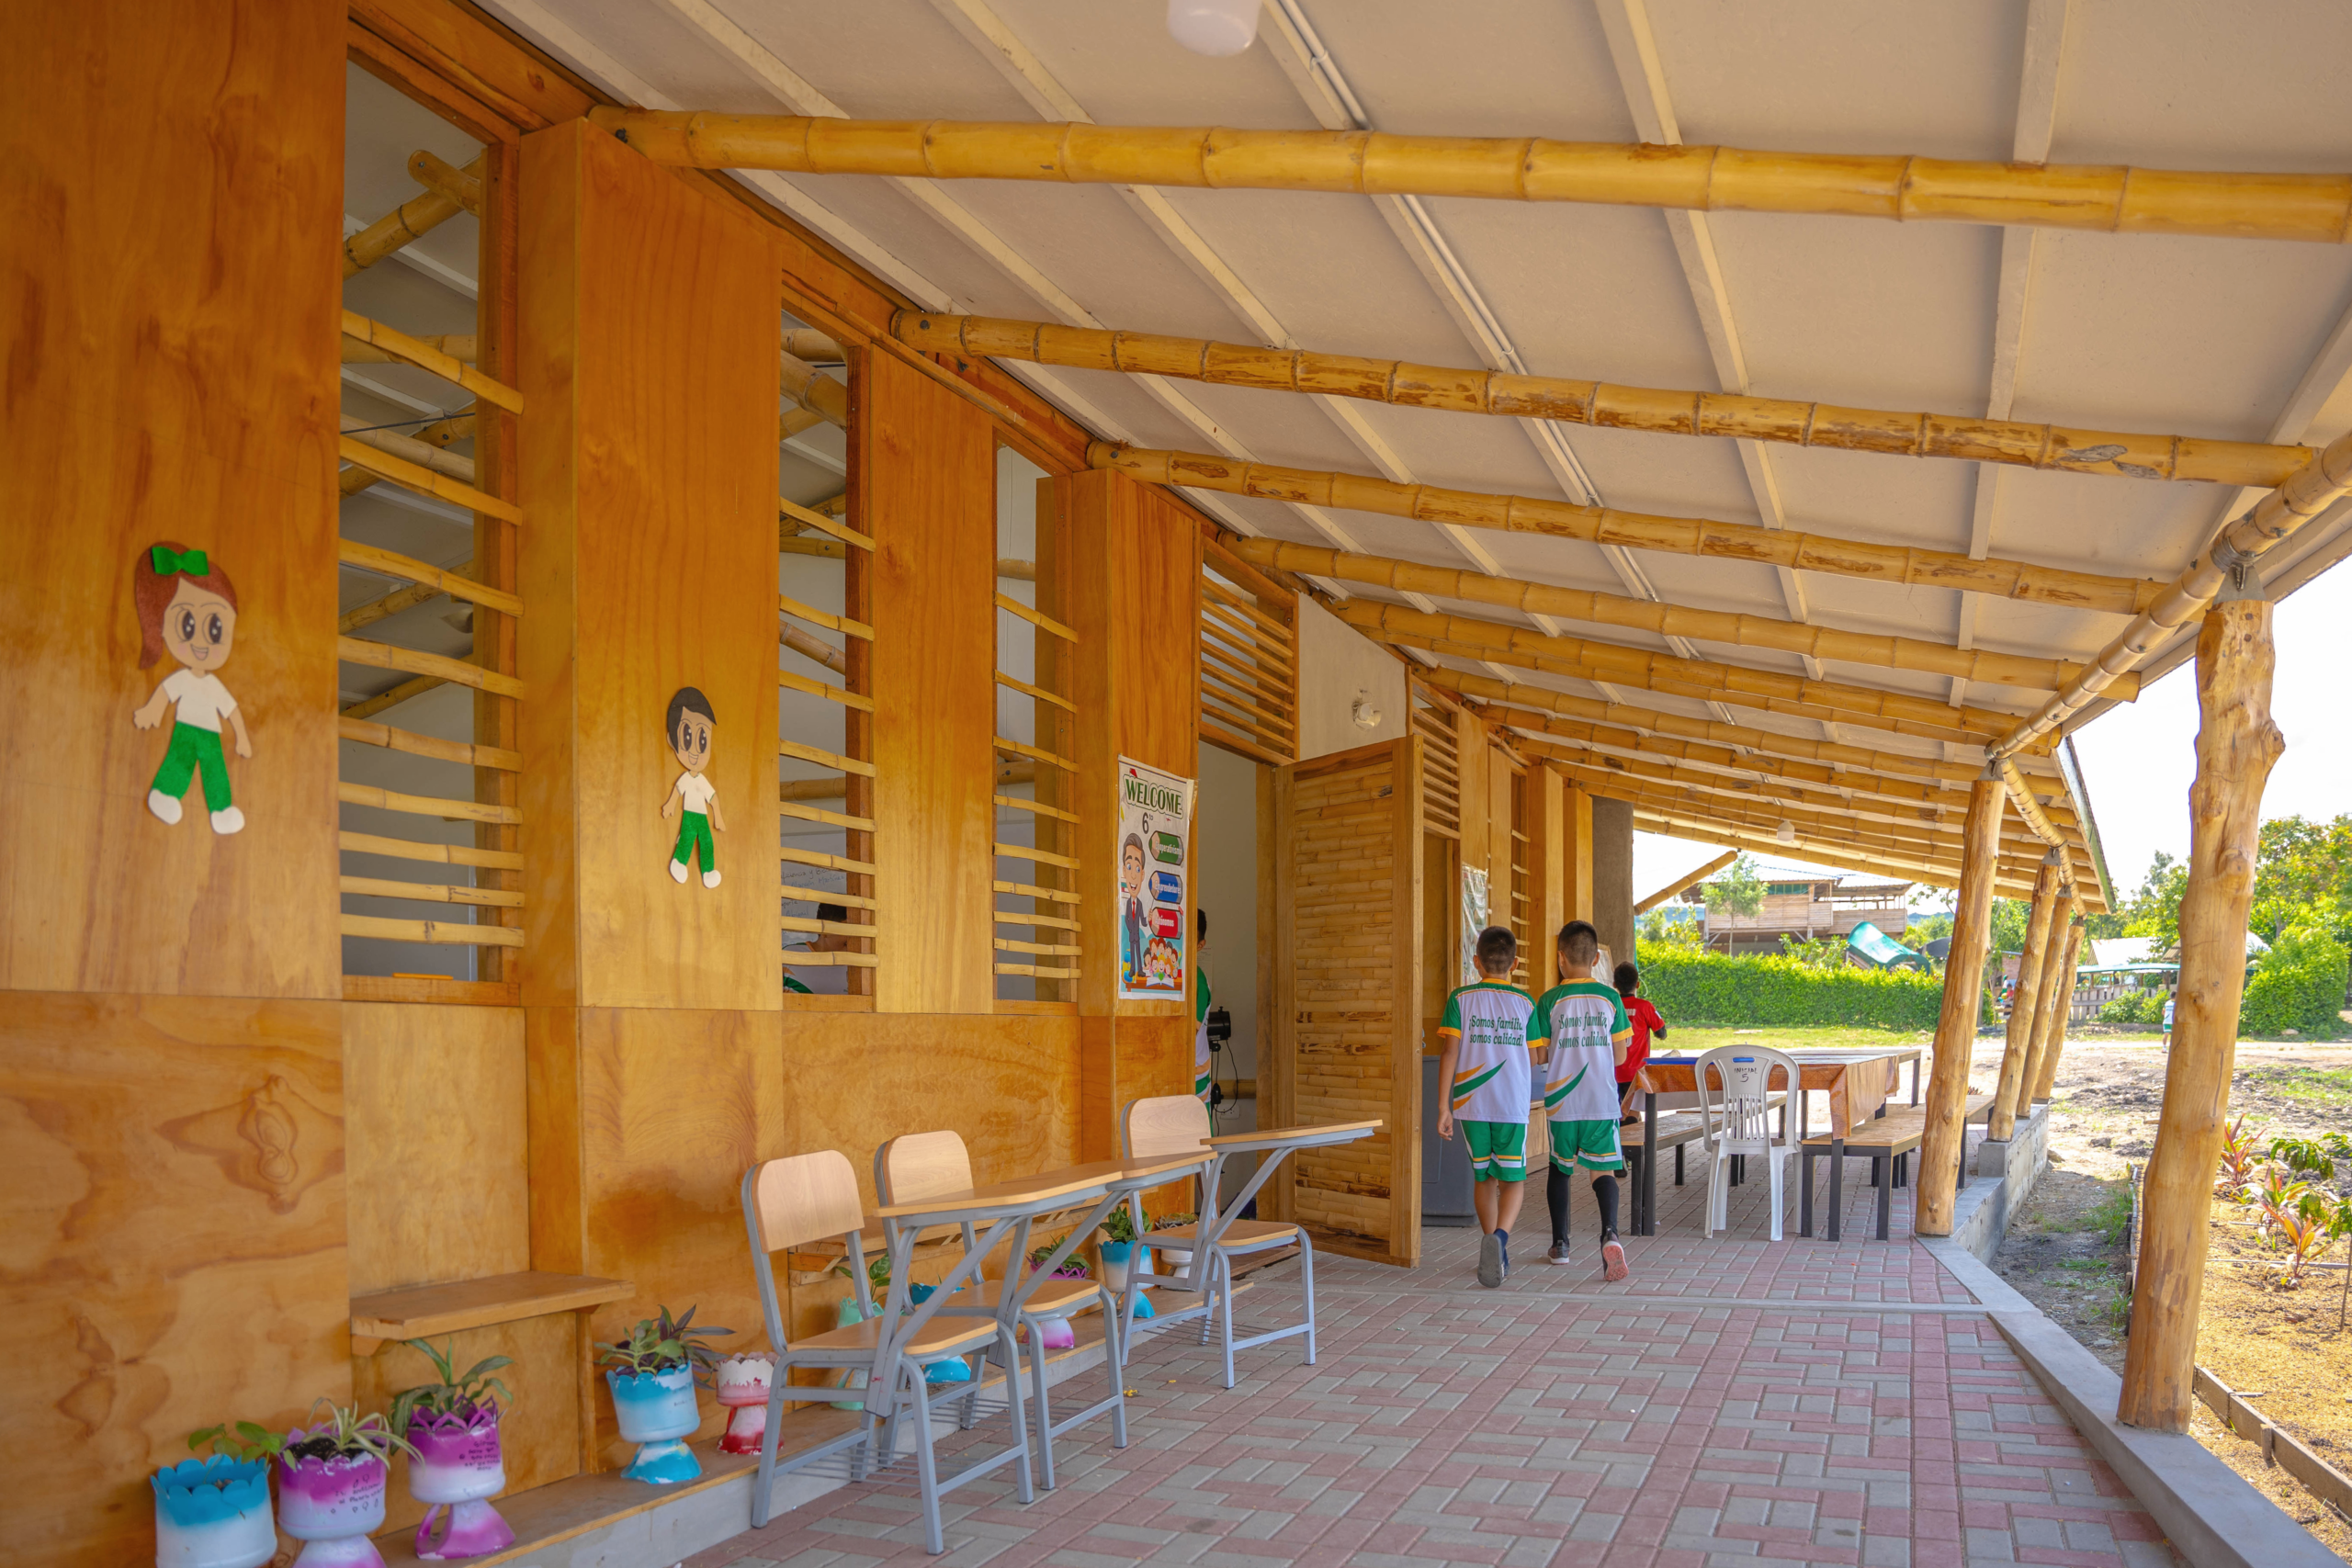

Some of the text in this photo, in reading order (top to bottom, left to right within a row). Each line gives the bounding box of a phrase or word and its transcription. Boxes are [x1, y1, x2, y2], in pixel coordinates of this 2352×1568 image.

[1125, 779, 1182, 816] WELCOME
[1155, 880, 1182, 895] Emprendedores
[1469, 1034, 1492, 1044] somos
[1558, 1036, 1579, 1050] somos
[1740, 1073, 1749, 1083] 5
